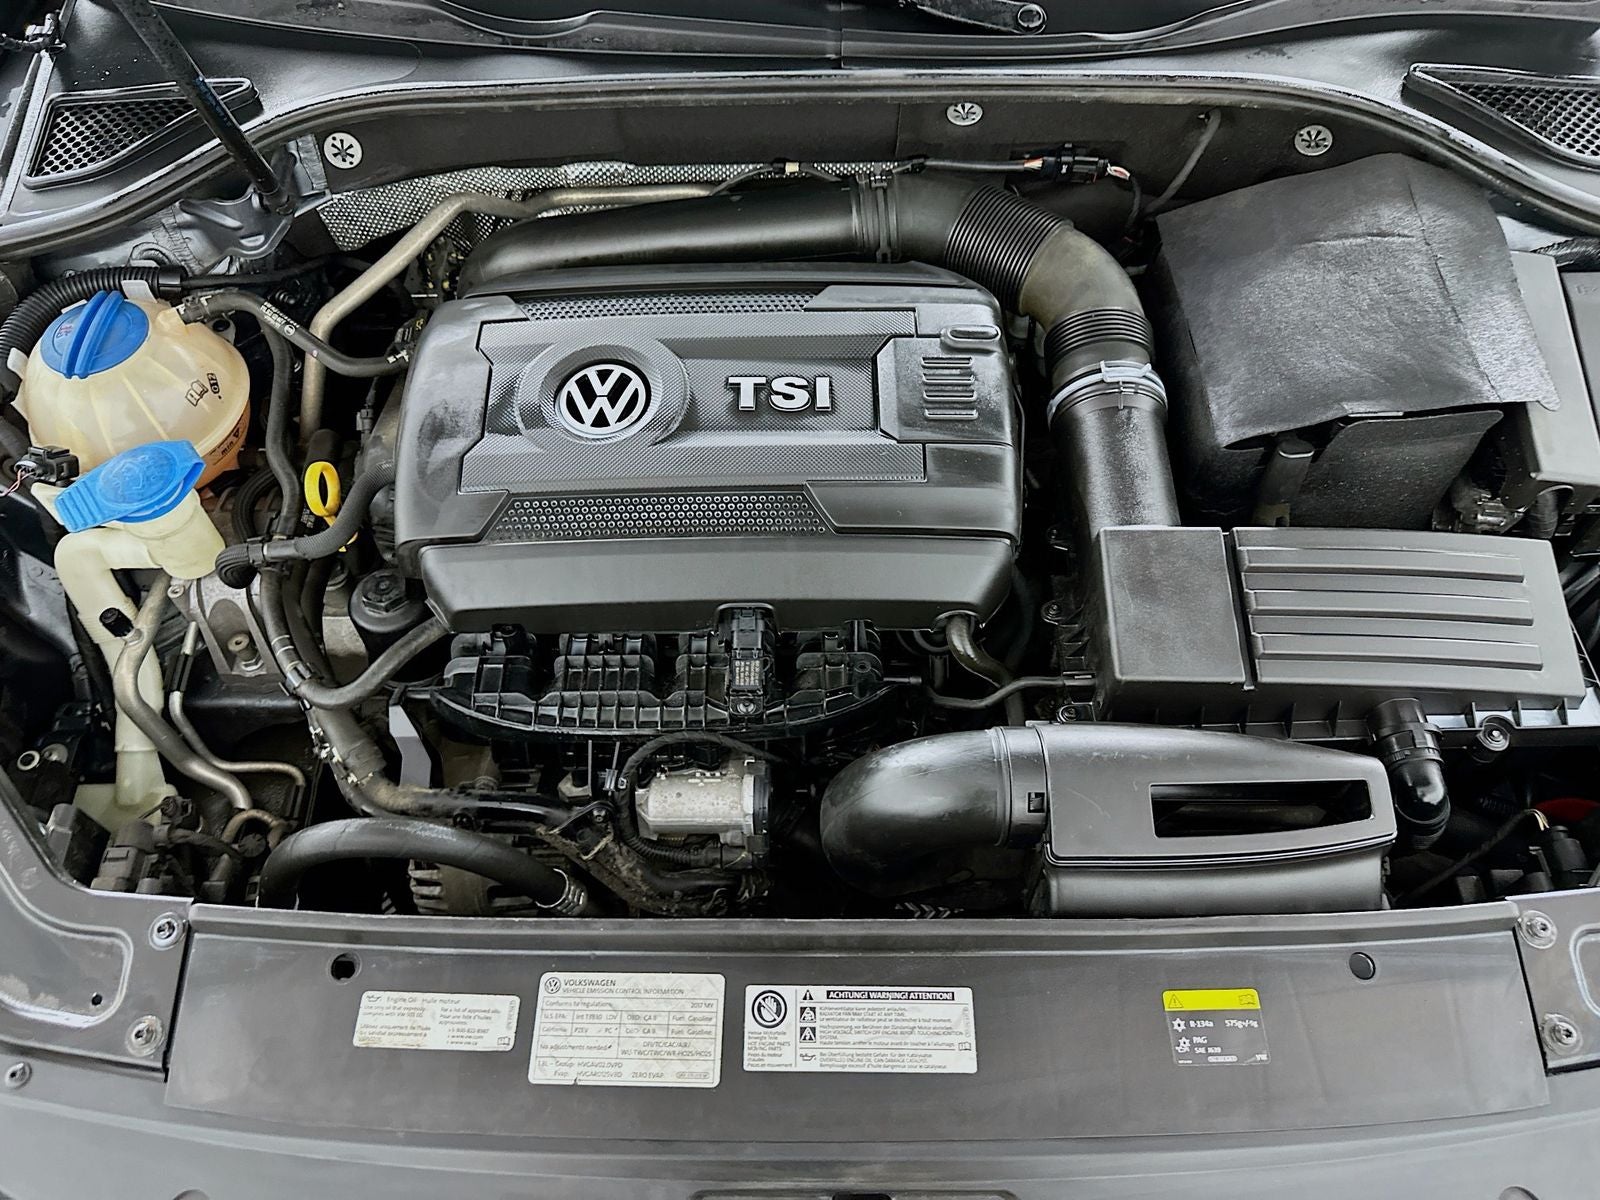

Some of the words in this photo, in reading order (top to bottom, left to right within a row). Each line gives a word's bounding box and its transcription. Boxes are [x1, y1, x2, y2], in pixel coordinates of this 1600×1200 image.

[727, 375, 834, 413] TSI
[221, 440, 235, 455] min
[563, 979, 617, 987] VOLKSWAGEN
[829, 991, 868, 999] ACHTUNG!
[868, 991, 908, 1000] WARNING!
[909, 992, 953, 1000] ATTENTION!
[1192, 1036, 1208, 1044] PAG
